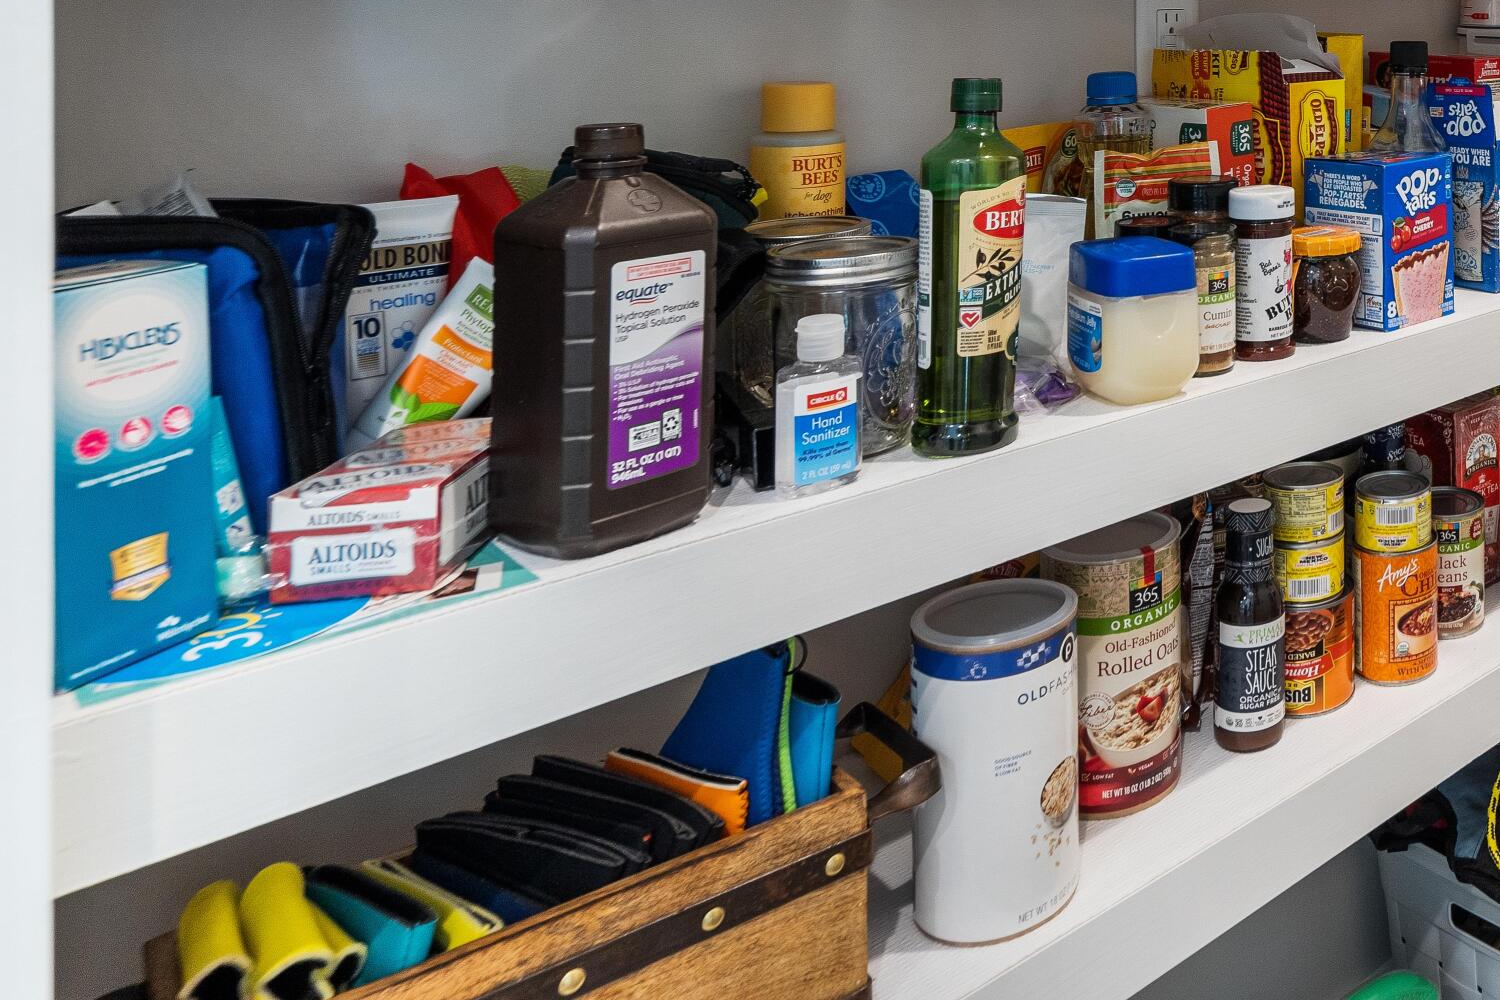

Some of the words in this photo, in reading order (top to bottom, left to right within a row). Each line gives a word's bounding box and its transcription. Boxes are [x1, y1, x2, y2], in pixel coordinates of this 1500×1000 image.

[1485, 60, 1498, 69] Aunt
[1479, 68, 1500, 78] Jemima
[1310, 98, 1323, 119] OLD
[1449, 100, 1477, 116] tarts
[1238, 121, 1250, 151] 365
[1314, 120, 1325, 137] EL
[1065, 135, 1077, 148] 60
[1450, 146, 1469, 154] READY
[1471, 148, 1490, 156] WHEN
[792, 155, 842, 172] BURT'S
[1452, 154, 1470, 164] YOU
[1472, 156, 1491, 166] ARE
[801, 170, 838, 186] BEES
[804, 192, 813, 200] for
[813, 189, 832, 203] dogs
[1333, 184, 1362, 192] UNTOASTED
[1320, 196, 1367, 210] RENEGADES.
[1406, 190, 1436, 216] tarts
[985, 209, 1024, 230] BERT
[1413, 220, 1434, 234] CHERRY
[1260, 260, 1272, 270] Bad
[369, 268, 435, 284] ULTIMATE
[616, 283, 668, 302] equate
[986, 275, 1018, 301] EXTRA
[1212, 280, 1227, 291] 365
[370, 292, 436, 311] healing
[1387, 301, 1396, 318] 8
[616, 307, 660, 322] Hydrogen
[663, 300, 699, 313] Peroxide
[1203, 309, 1232, 321] Cumin
[353, 318, 381, 339] 10
[616, 321, 648, 334] Topical
[650, 314, 686, 328] Solution
[812, 411, 842, 430] Hand
[802, 426, 850, 445] Sanitizer
[1408, 433, 1424, 447] TEA
[612, 460, 625, 473] 32
[640, 453, 655, 465] OZ
[1466, 459, 1496, 476] ORGANICS
[802, 471, 808, 480] 2
[1487, 482, 1499, 493] TEA
[307, 511, 364, 527] ALTOIDS
[1440, 530, 1457, 541] 365
[308, 540, 396, 565] ALTOIDS
[1439, 542, 1471, 552] GANIC
[311, 563, 352, 575] SMALLS
[1439, 555, 1467, 569] lack
[1377, 557, 1419, 593] Amy's
[1438, 570, 1468, 583] eans
[1401, 574, 1437, 597] CHI
[1134, 586, 1158, 608] 365
[1111, 599, 1174, 630] ORGANIC
[1105, 617, 1176, 653] Old-Fashioned
[1098, 649, 1153, 676] Rolled
[1157, 639, 1179, 660] Oats
[1246, 645, 1277, 672] STEAK
[1287, 650, 1315, 660] BAKED
[1245, 669, 1276, 694] SAUCE
[1240, 688, 1278, 704] ORGANIC
[1285, 686, 1311, 702] BUS
[1240, 698, 1265, 710] SUGAR
[1138, 762, 1154, 771] VEGAN
[1102, 790, 1113, 799] NET
[1114, 788, 1123, 798] WT
[1124, 786, 1130, 795] 18
[1131, 784, 1139, 793] OZ
[1017, 908, 1035, 924] NET
[1036, 901, 1048, 915] WT
